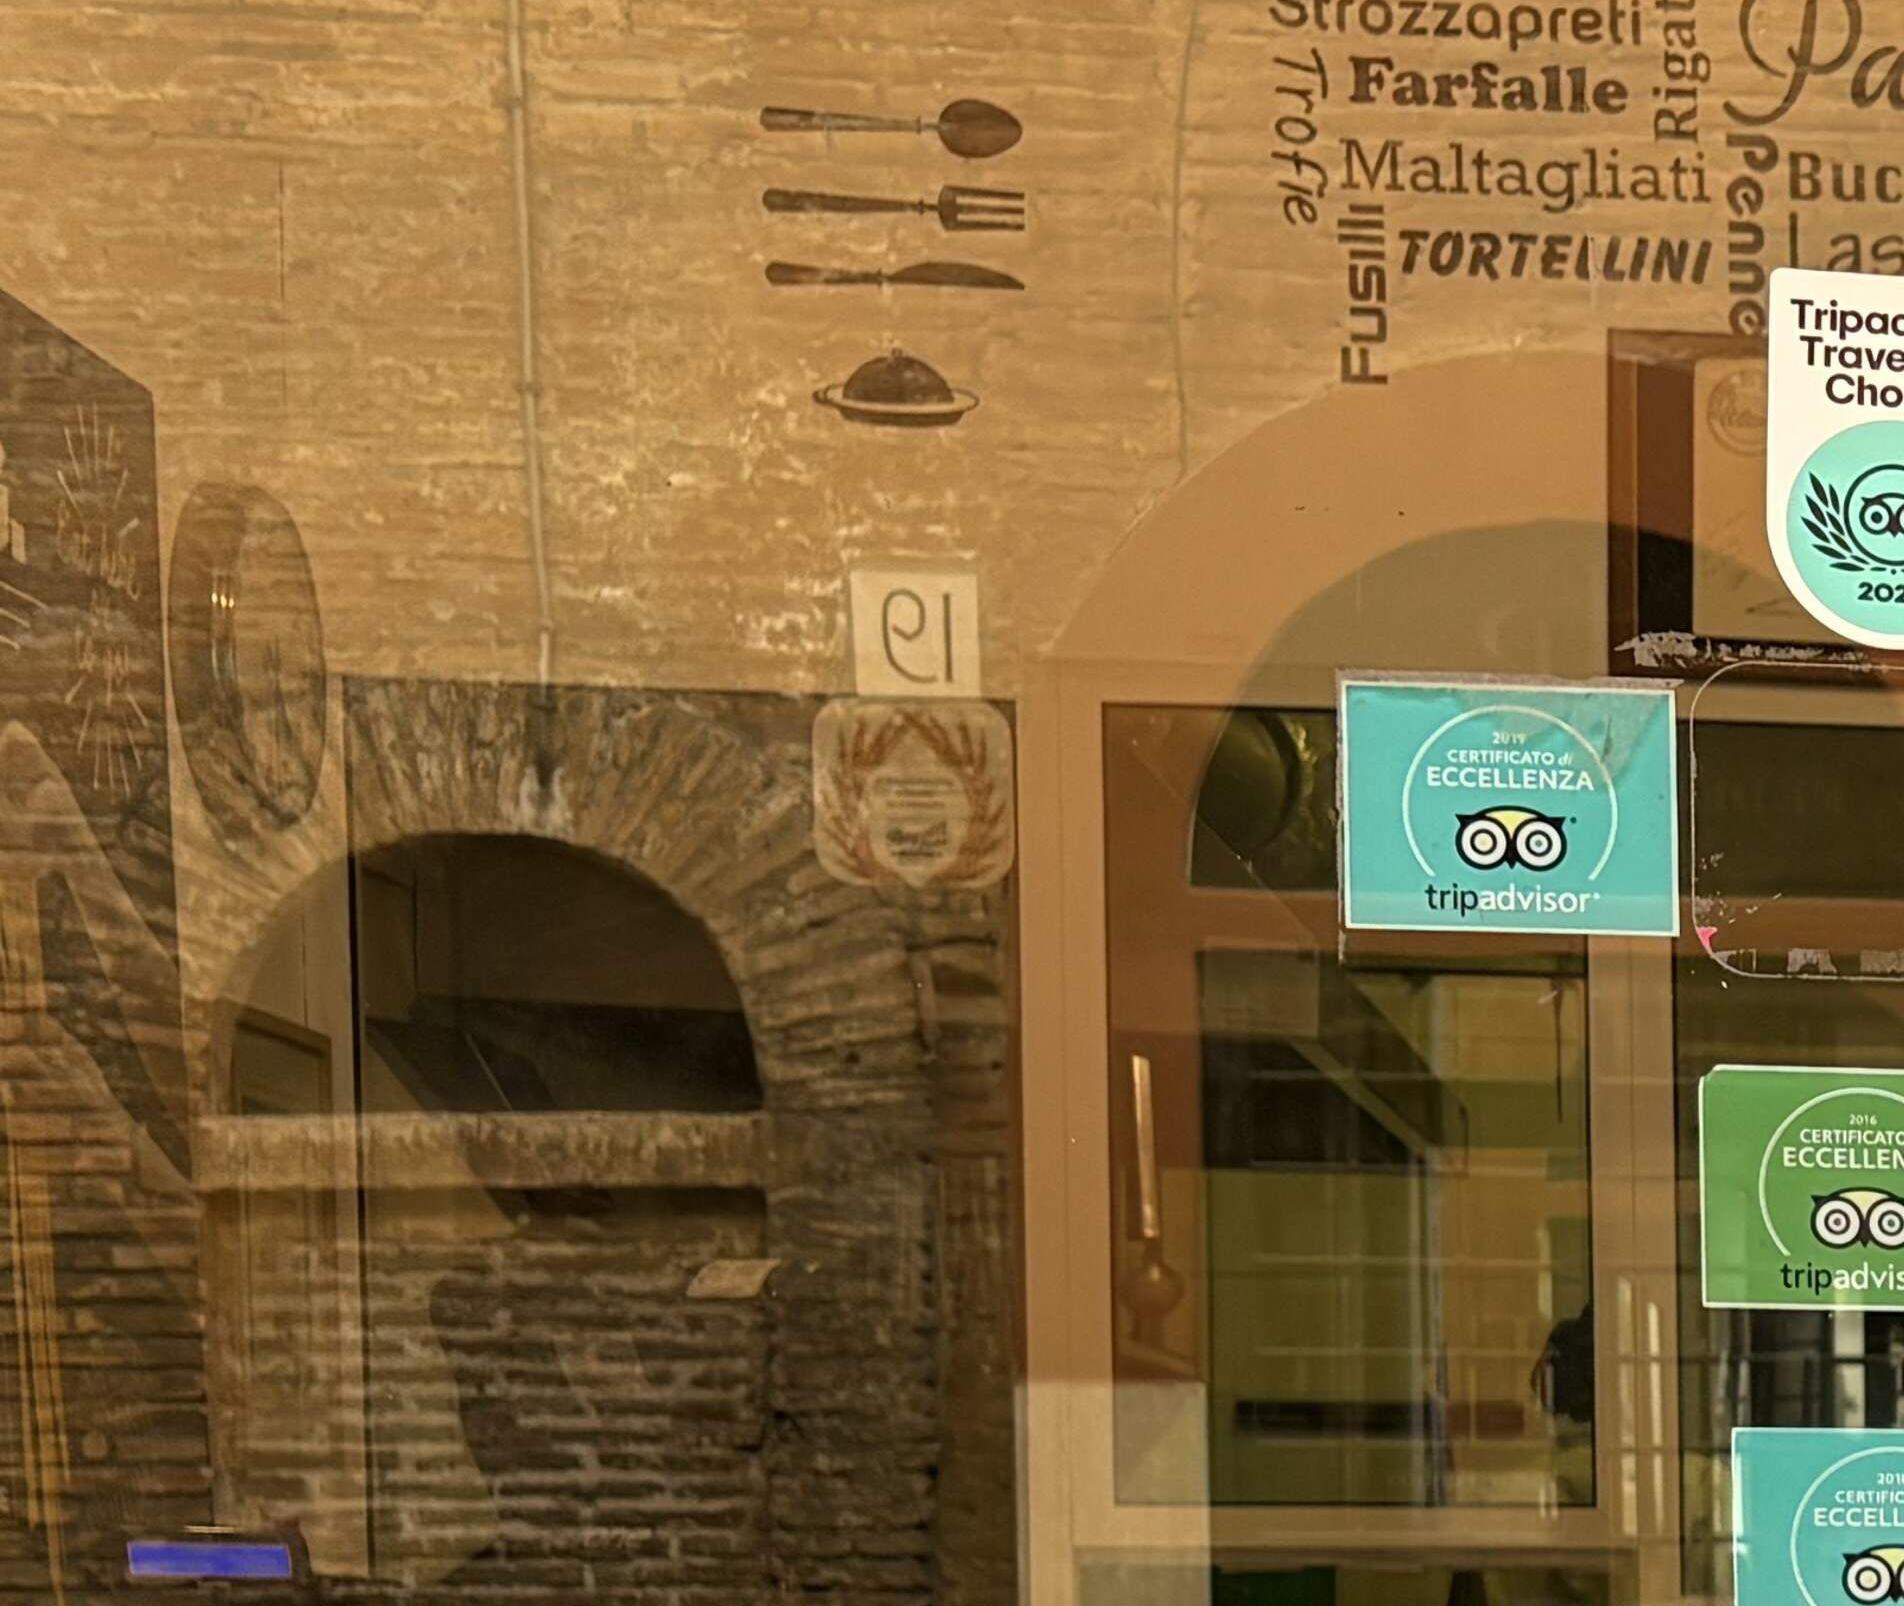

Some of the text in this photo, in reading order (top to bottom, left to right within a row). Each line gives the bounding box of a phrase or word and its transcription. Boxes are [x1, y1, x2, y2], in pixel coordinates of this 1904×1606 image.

[1348, 55, 1629, 115] Farfalle
[1272, 48, 1328, 226] Trofie
[1340, 138, 1711, 213] Maltagliati
[1399, 230, 1712, 285] TORTELLINI
[1338, 204, 1389, 385] Fusilli
[1426, 766, 1594, 791] ECCELLENZA
[1447, 749, 1555, 767] CERTIFICATO
[1425, 883, 1590, 917] tripadvisor
[1849, 1114, 1878, 1126] 2016
